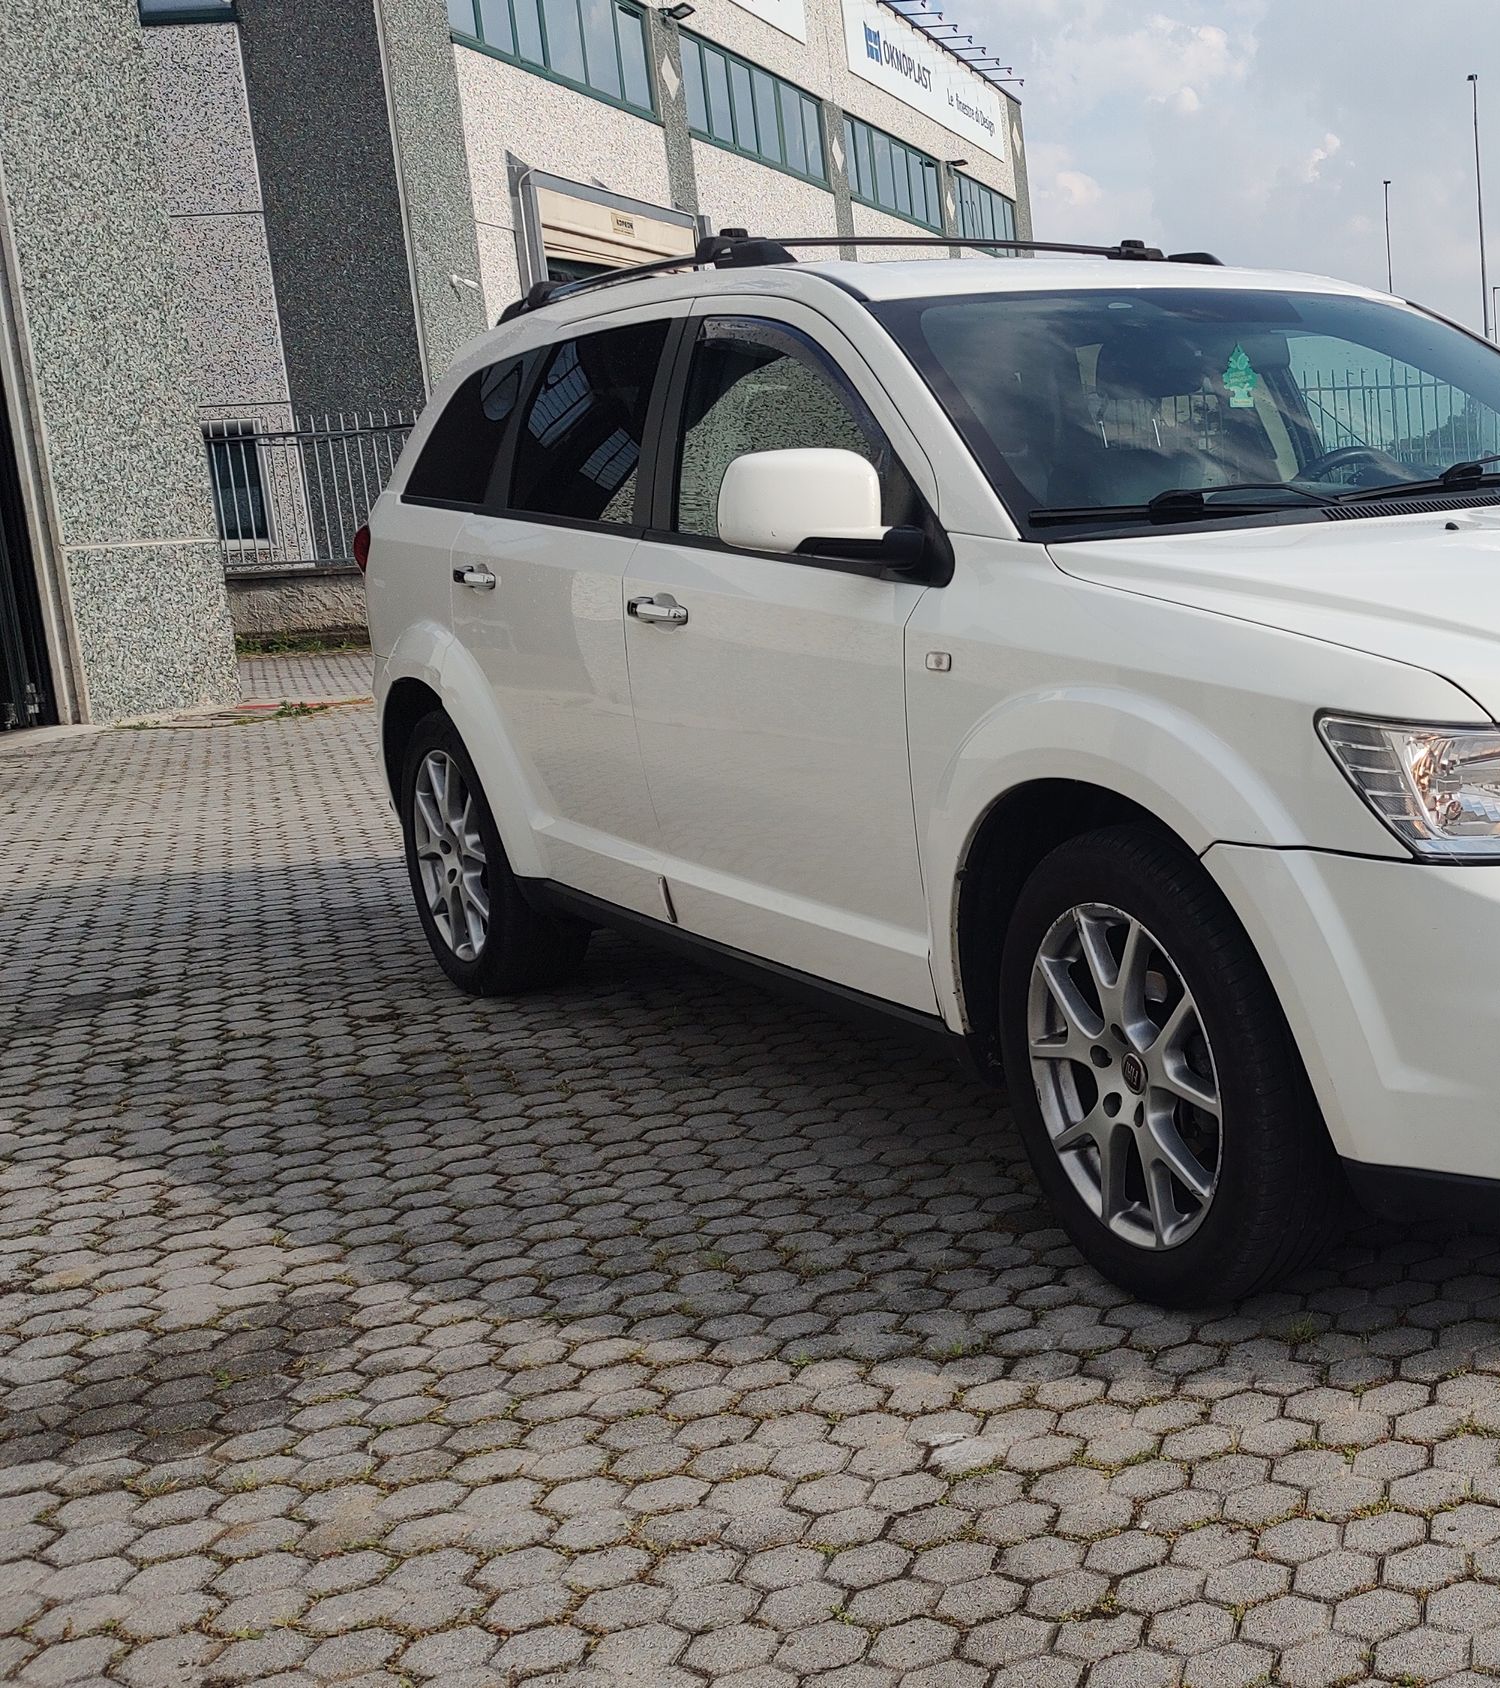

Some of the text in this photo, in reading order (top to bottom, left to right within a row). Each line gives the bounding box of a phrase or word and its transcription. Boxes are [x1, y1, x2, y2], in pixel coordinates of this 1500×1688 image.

[882, 40, 932, 92] OKNOPLAST
[946, 87, 955, 107] Le
[980, 110, 996, 137] Design
